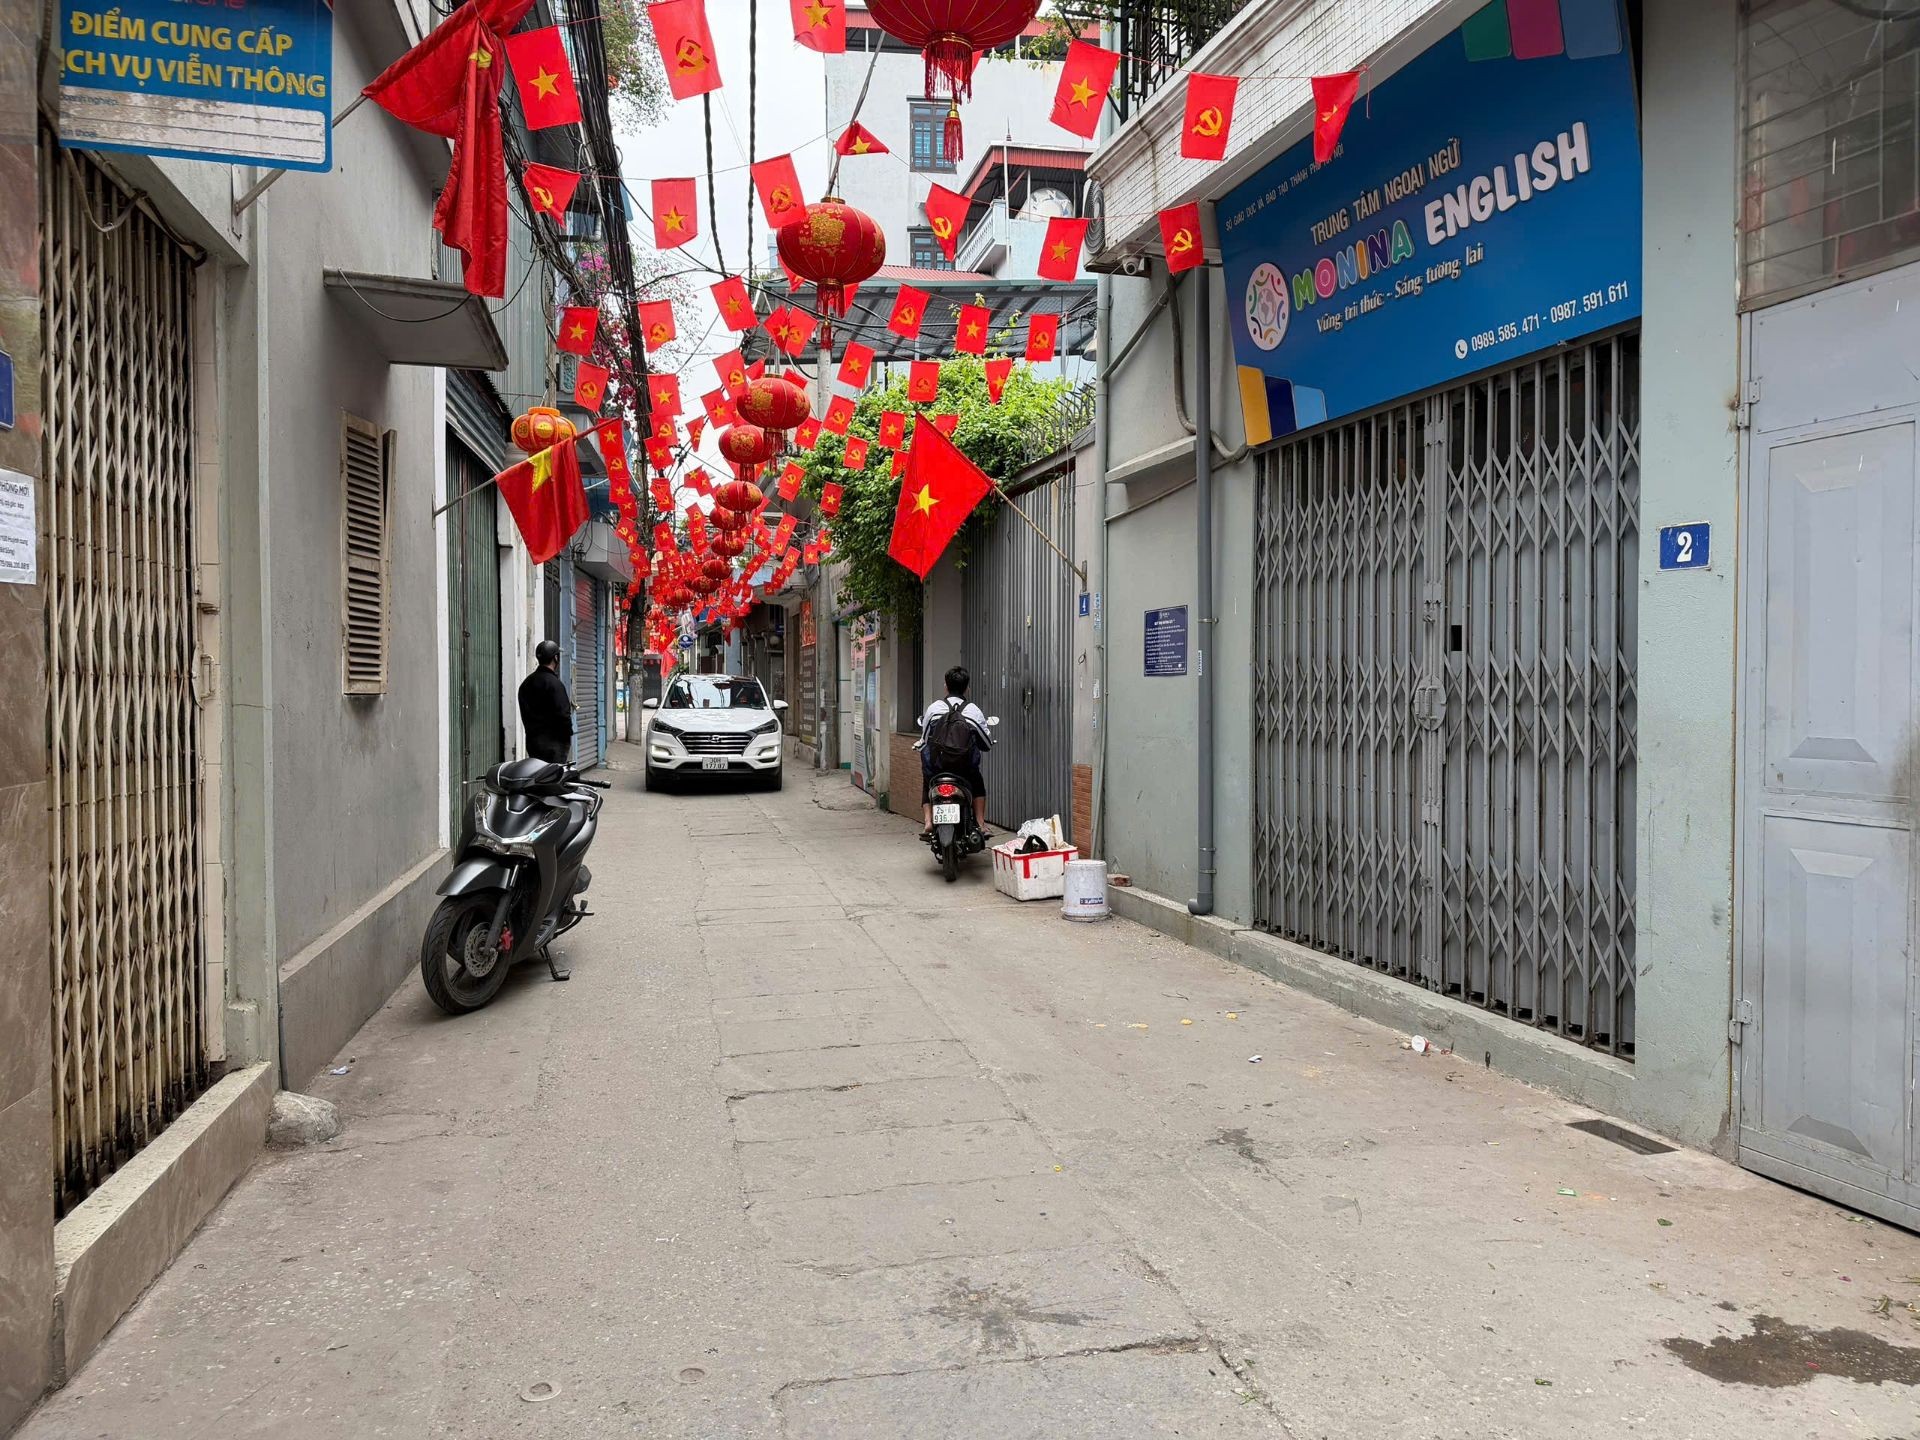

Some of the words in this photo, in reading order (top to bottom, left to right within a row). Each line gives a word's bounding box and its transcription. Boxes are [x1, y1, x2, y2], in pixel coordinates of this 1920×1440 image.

[70, 7, 146, 41] ĐIỂM
[151, 20, 232, 51] CUNG
[237, 25, 293, 56] CẤP
[60, 48, 106, 78] ỊCH
[110, 53, 152, 87] VỤ
[157, 53, 222, 87] VIỄN
[226, 65, 326, 98] THÔNG
[1292, 219, 1415, 311] MONINA
[1424, 121, 1591, 246] ENGLISH
[1311, 208, 1350, 246] TRUNG
[1353, 190, 1381, 222] TÂM
[1384, 163, 1425, 205] NGOẠI
[1428, 137, 1461, 180] NGỮ
[1360, 290, 1384, 314] thức
[1395, 275, 1423, 298] Sáng
[1426, 258, 1461, 284] tương
[1465, 242, 1484, 266] lai
[1471, 313, 1541, 352] 0989.585.471
[1676, 531, 1693, 563] 2
